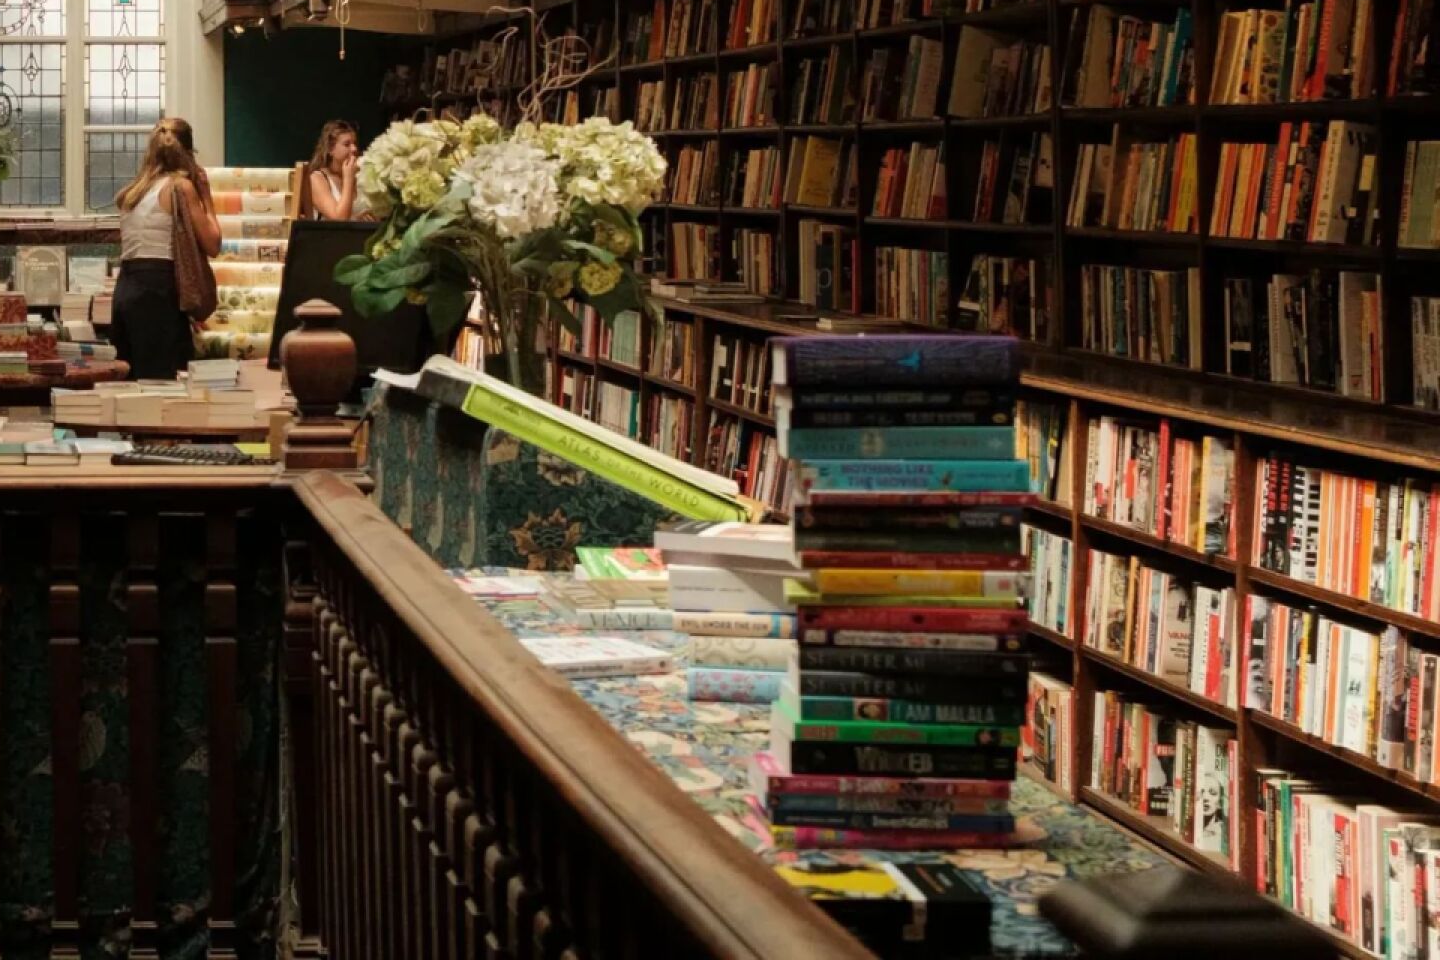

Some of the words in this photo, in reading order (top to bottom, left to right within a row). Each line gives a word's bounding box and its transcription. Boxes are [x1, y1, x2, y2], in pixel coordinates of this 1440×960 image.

[558, 436, 601, 461] ATLAS
[647, 477, 700, 508] WORLD
[840, 464, 903, 476] NOTHING
[848, 476, 873, 488] THE
[905, 705, 931, 721] AM
[935, 706, 995, 723] MALALA
